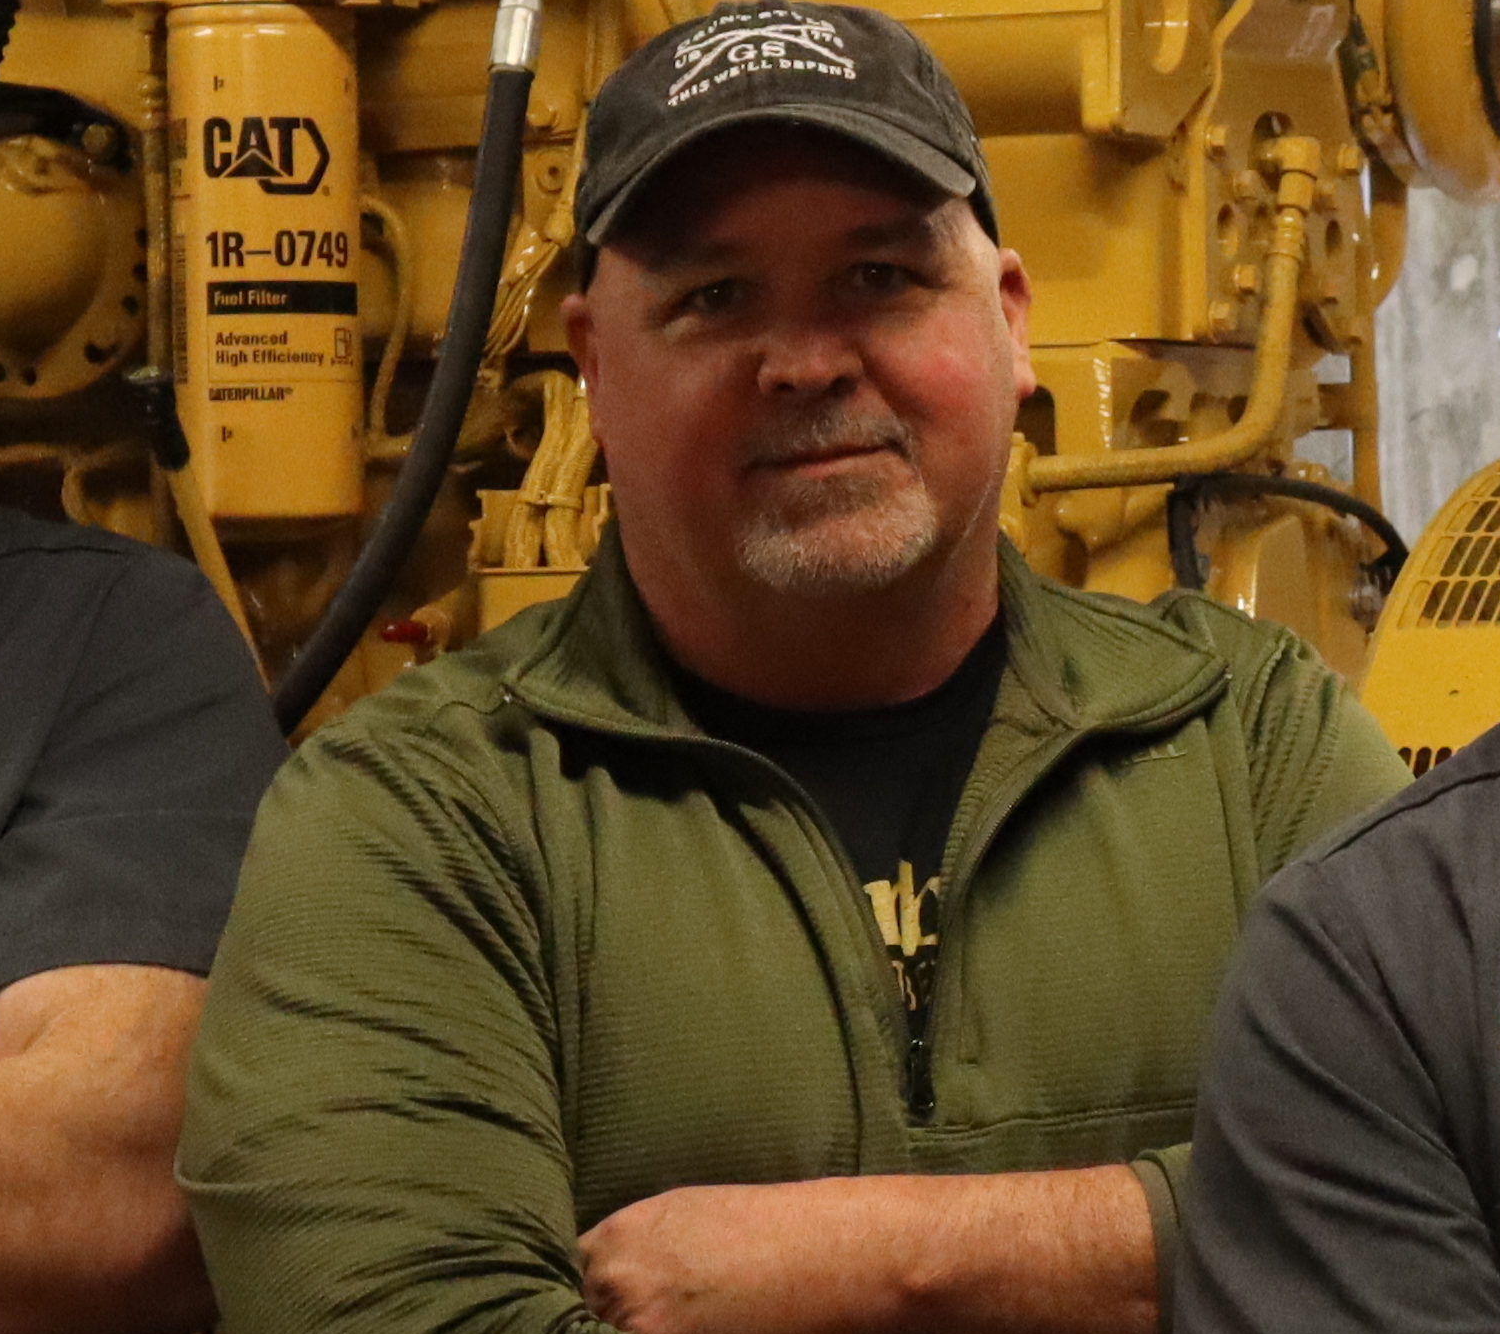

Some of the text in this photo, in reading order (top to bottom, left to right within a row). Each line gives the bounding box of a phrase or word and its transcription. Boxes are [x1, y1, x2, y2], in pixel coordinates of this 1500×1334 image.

[727, 40, 786, 63] GS
[667, 79, 711, 107] THIS
[779, 58, 857, 80] DEFEND
[203, 116, 301, 179] CAT
[205, 230, 349, 268] 1R-0749
[214, 289, 288, 306] Fuel Filter
[215, 330, 288, 346] Advanced
[215, 349, 325, 367] High Efficiency
